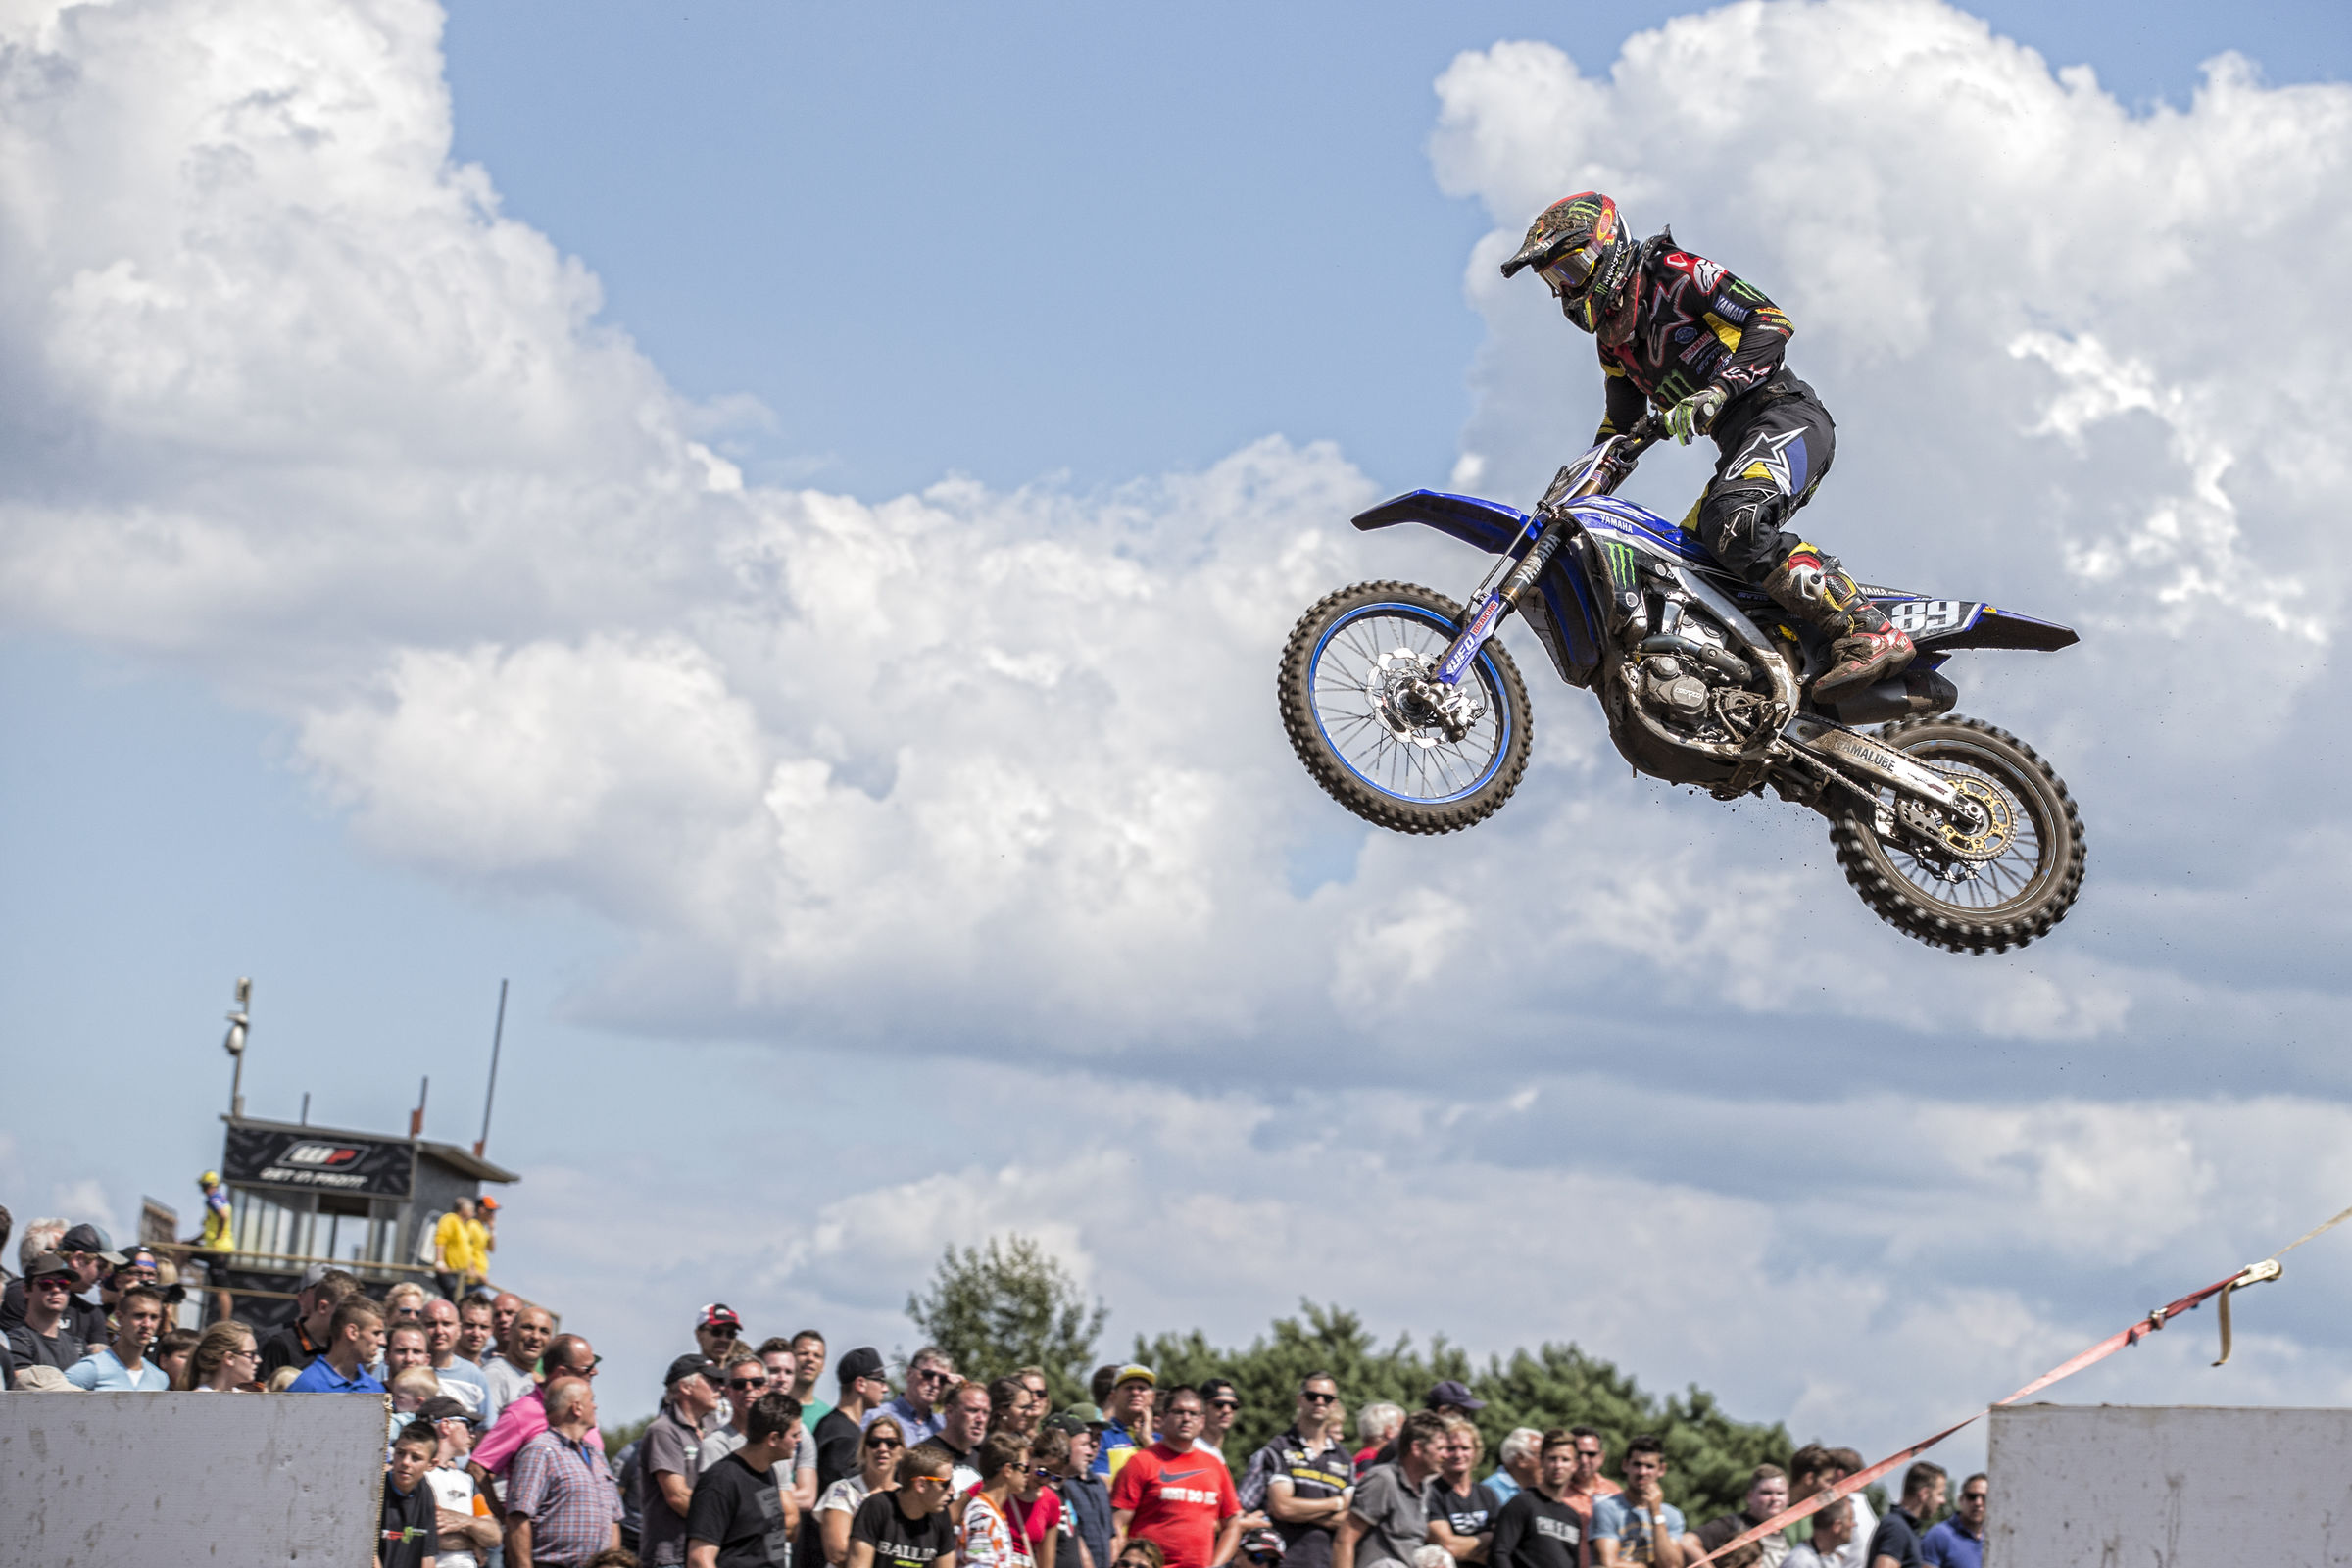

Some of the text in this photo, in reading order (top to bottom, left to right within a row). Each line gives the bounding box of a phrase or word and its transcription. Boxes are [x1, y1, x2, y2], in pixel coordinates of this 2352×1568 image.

[1603, 240, 1623, 285] MONSTER
[1716, 297, 1748, 323] YAMAH
[1600, 514, 1633, 534] YAMAHA
[1514, 534, 1561, 584] YAMAHA
[1472, 602, 1497, 635] BRAKING
[1892, 600, 1959, 633] 89
[1161, 1487, 1186, 1501] JUST
[1187, 1489, 1203, 1503] DO
